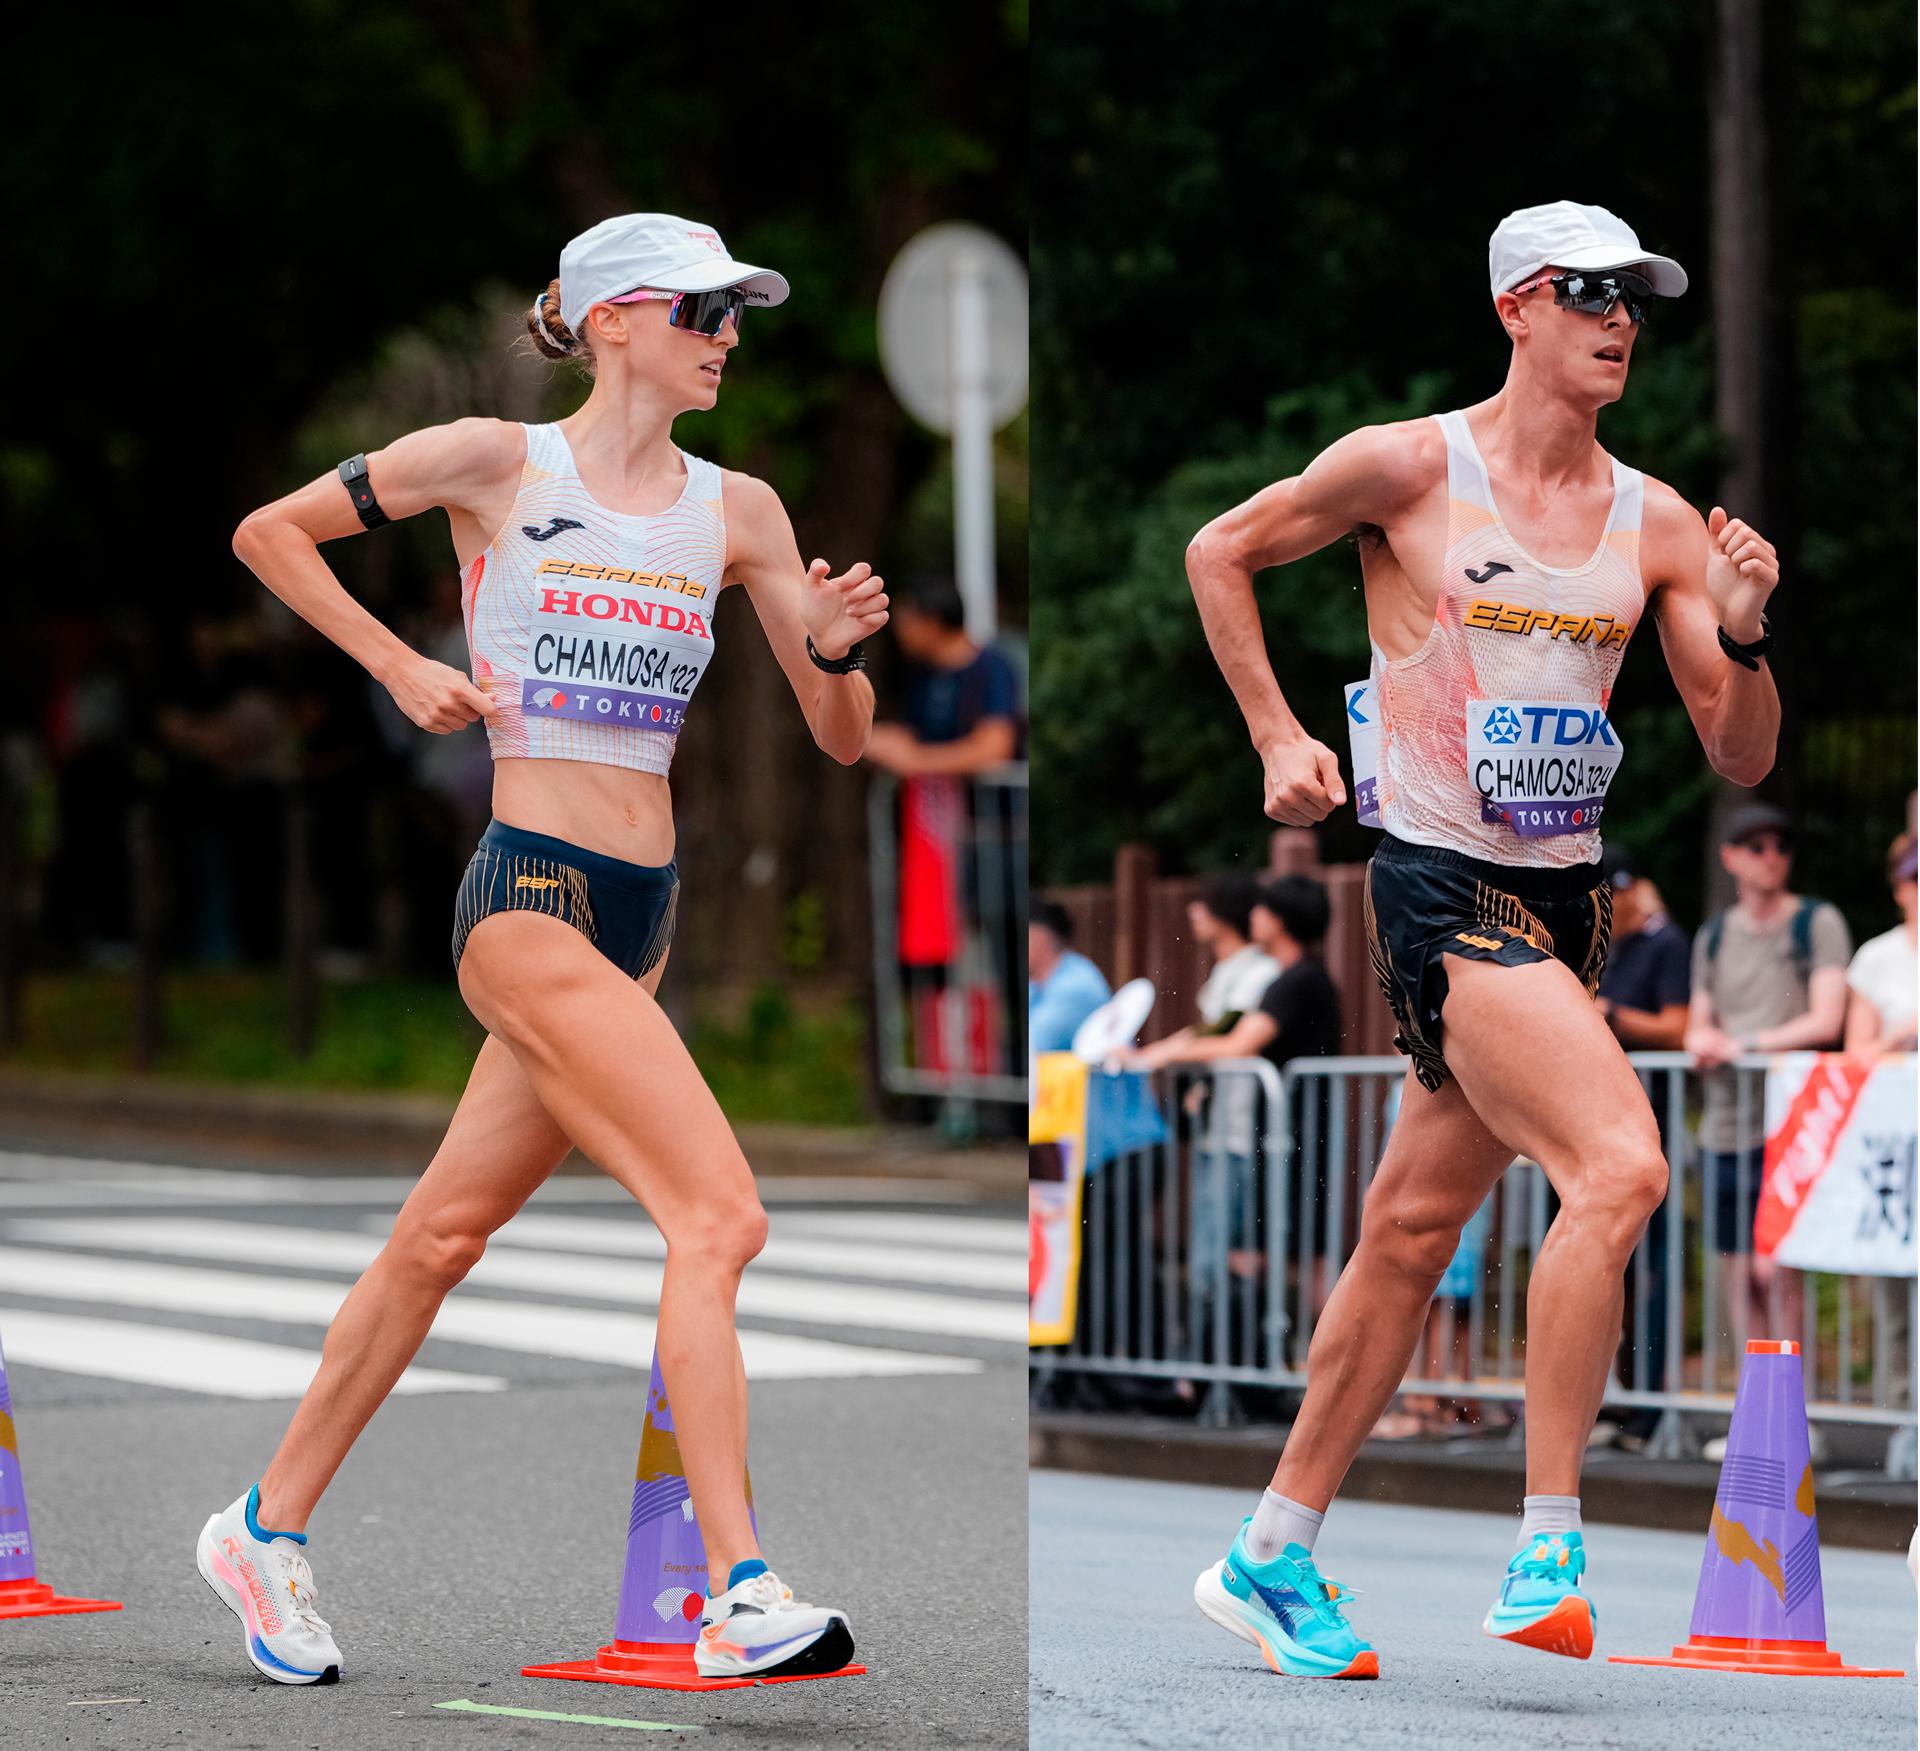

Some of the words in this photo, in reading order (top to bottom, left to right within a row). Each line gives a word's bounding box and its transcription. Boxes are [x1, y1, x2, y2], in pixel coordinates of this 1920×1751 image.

[538, 588, 711, 640] HONDA
[1463, 599, 1631, 650] ESPAÑA
[534, 633, 670, 690] CHAMOSA
[669, 664, 698, 695] 122
[1522, 707, 1615, 746] TDK
[1475, 757, 1584, 798] CHAMOSA
[1585, 765, 1612, 795] 324
